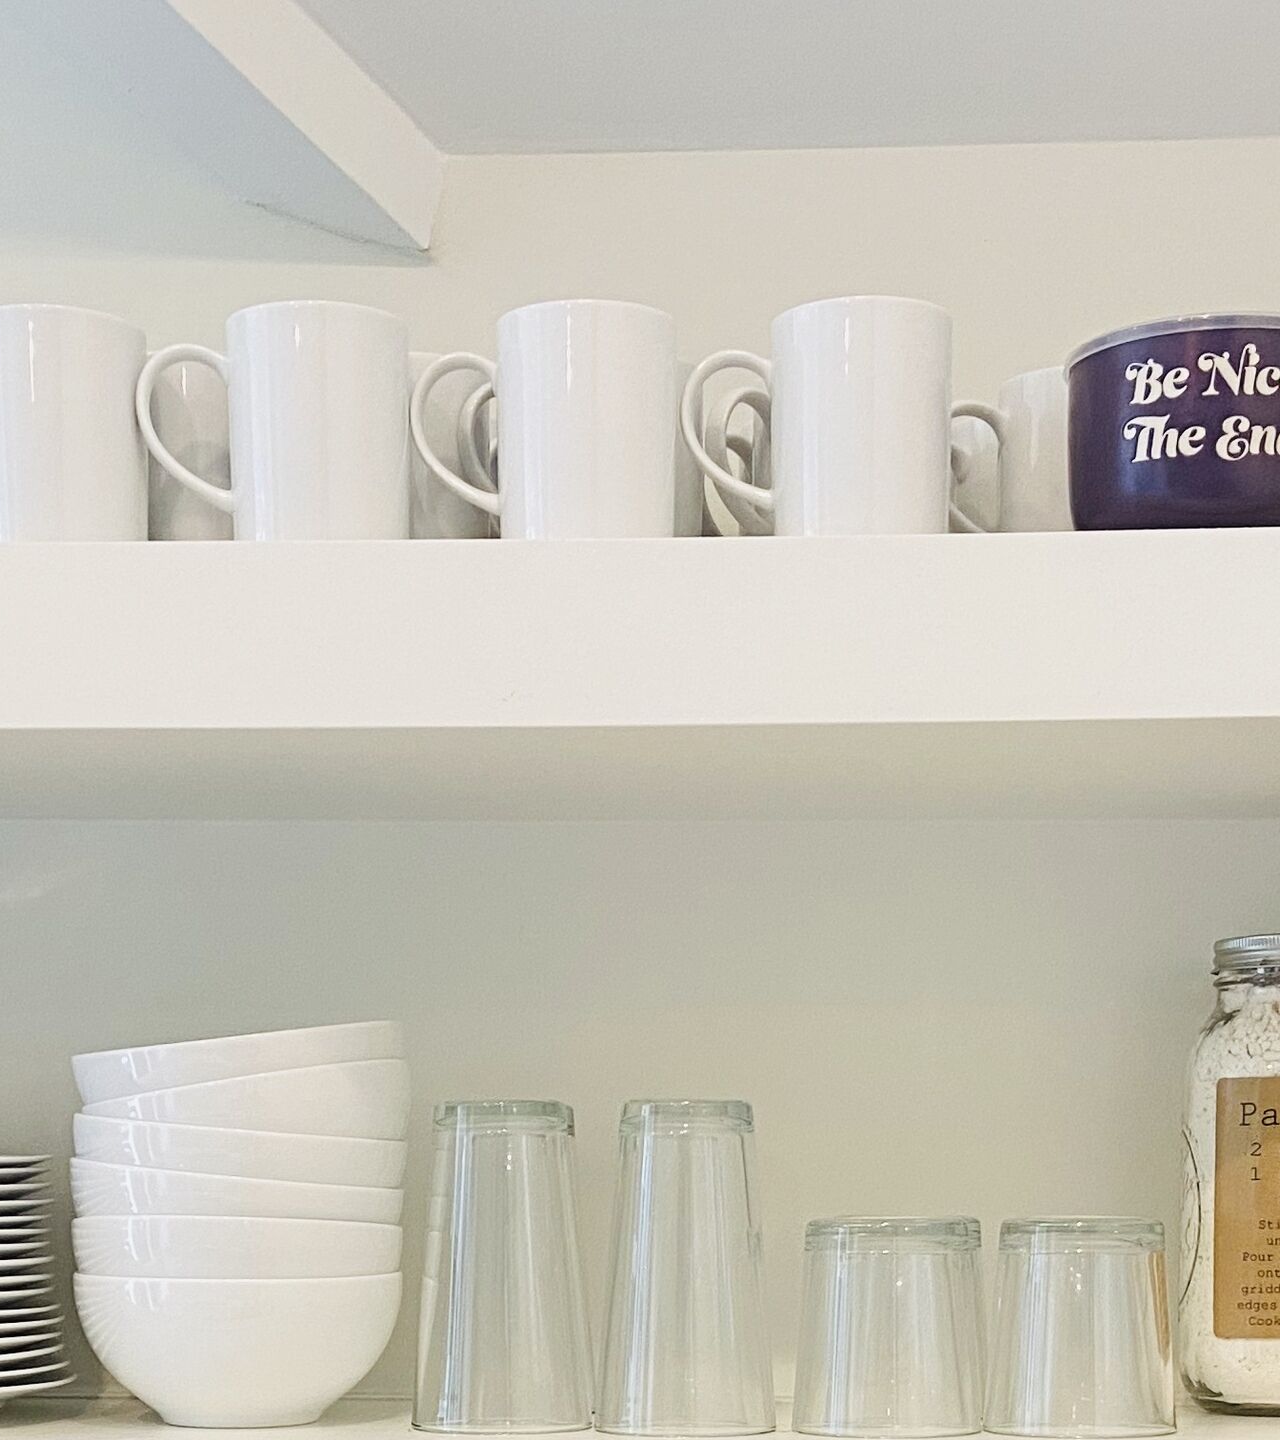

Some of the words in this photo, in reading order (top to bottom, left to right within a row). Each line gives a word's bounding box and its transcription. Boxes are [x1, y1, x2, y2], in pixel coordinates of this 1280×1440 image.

[1125, 358, 1189, 406] Be
[1123, 414, 1206, 463] The
[1250, 1142, 1261, 1156] 2
[1251, 1167, 1260, 1180] 1
[1243, 1252, 1273, 1261] Pour
[1237, 1301, 1276, 1311] edges
[1249, 1317, 1280, 1326] Cook
